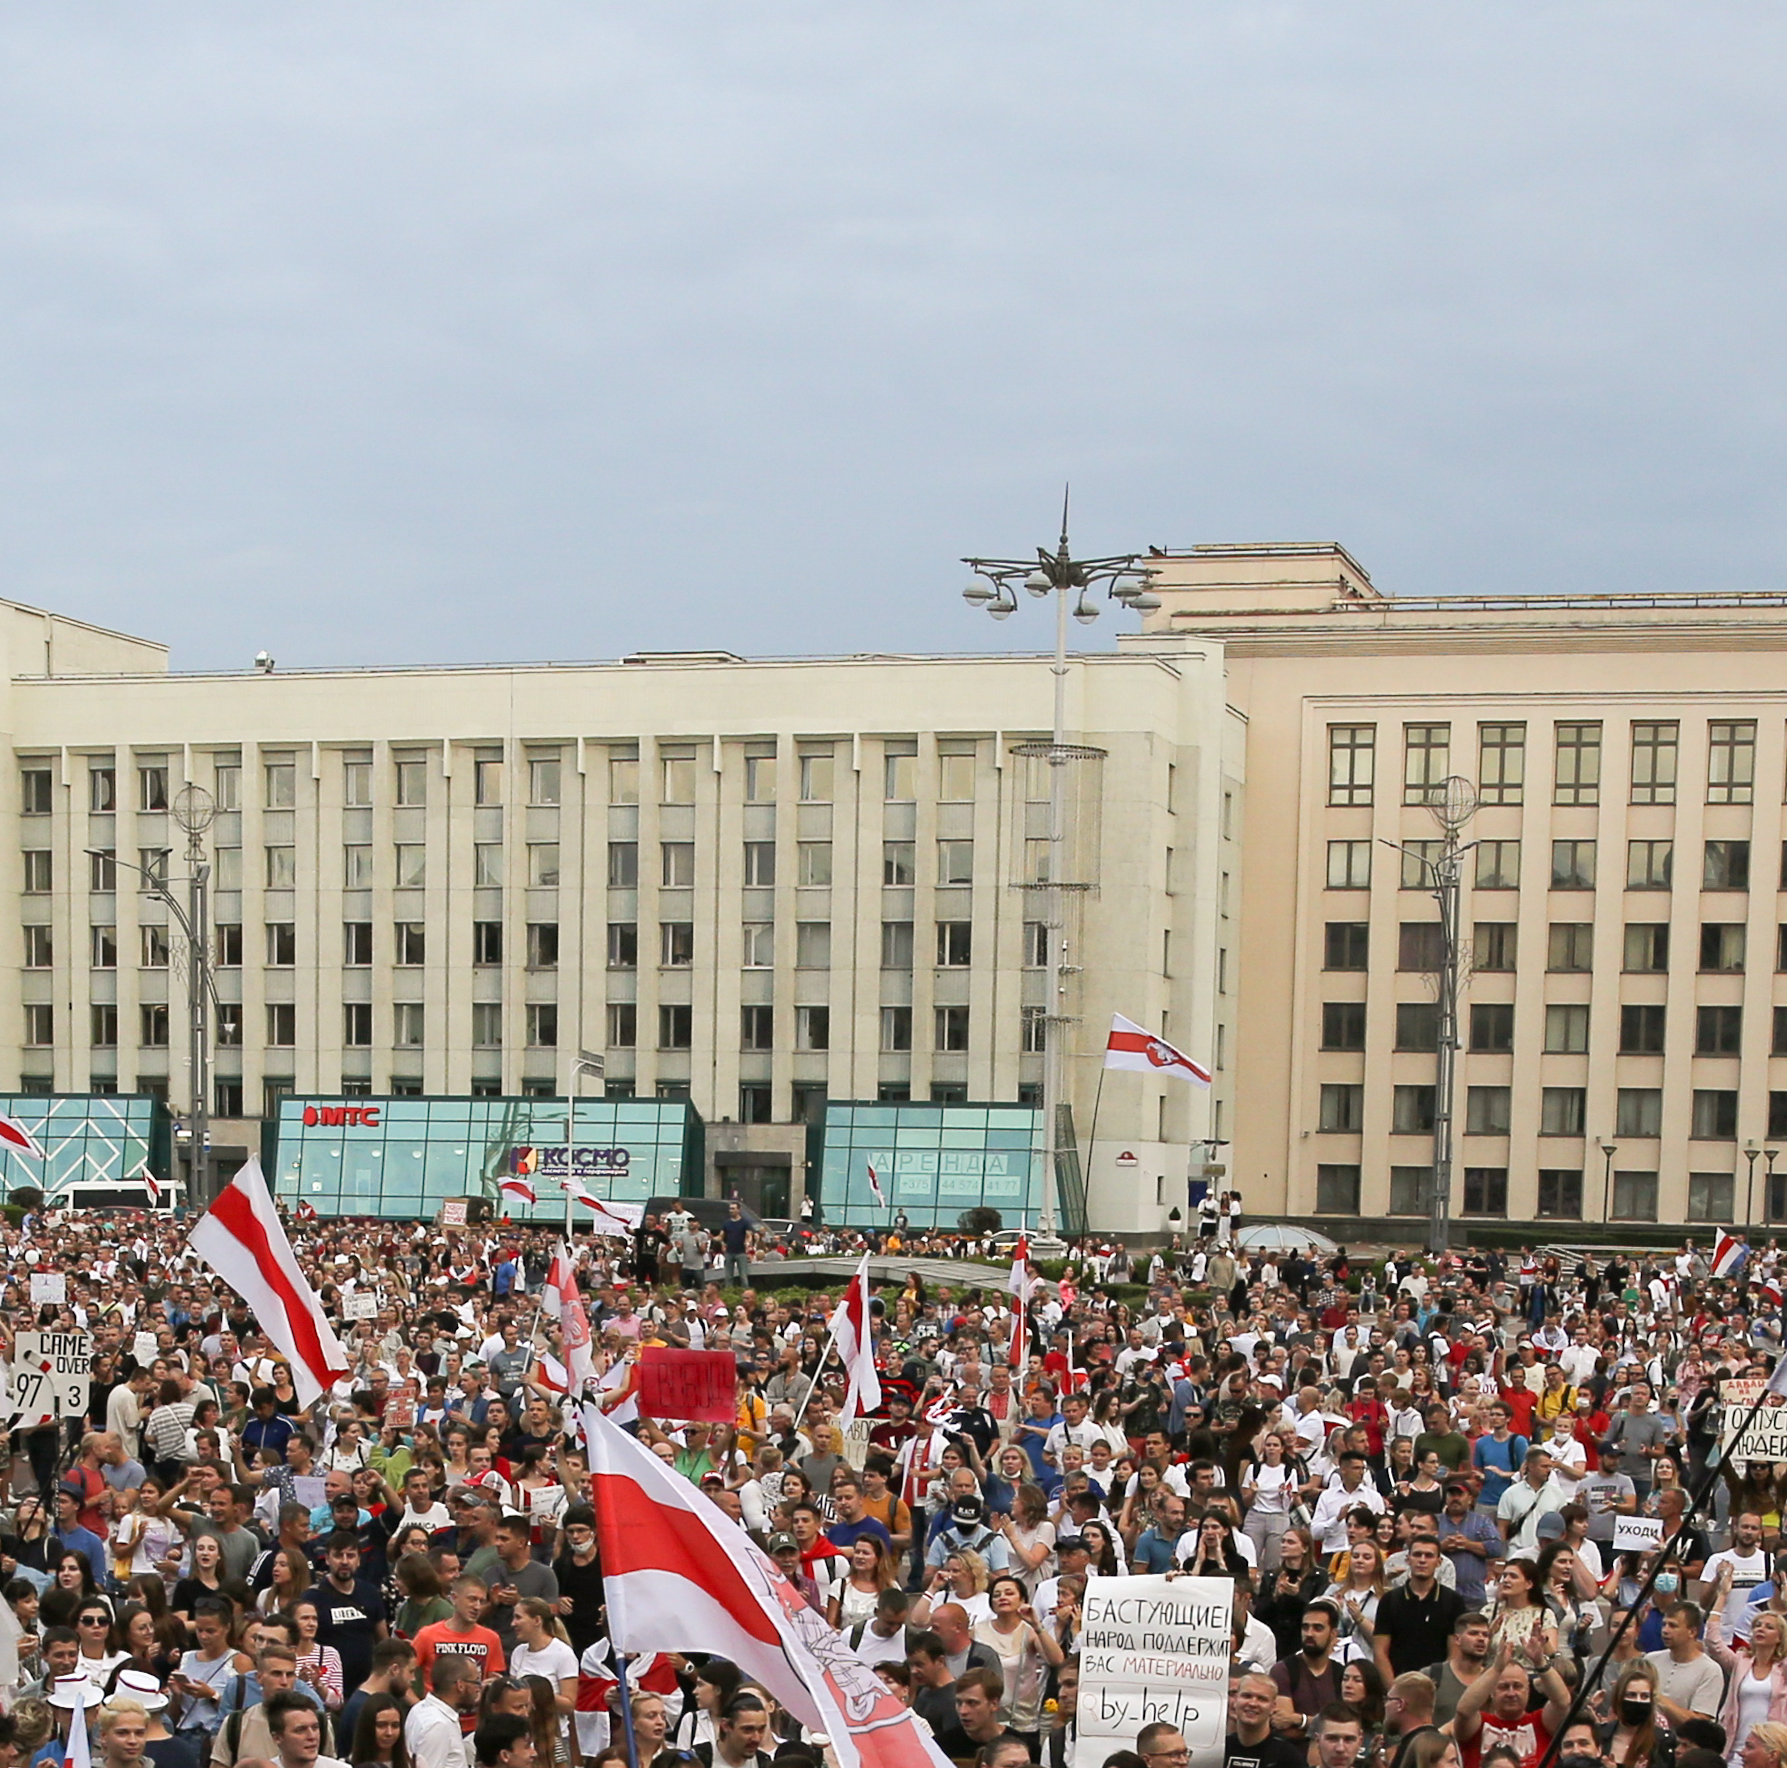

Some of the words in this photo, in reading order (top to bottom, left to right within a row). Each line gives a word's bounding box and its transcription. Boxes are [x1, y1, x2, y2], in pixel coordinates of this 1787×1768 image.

[320, 1107, 380, 1127] МТС
[542, 1147, 631, 1167] КОСМО
[875, 1153, 1004, 1173] АРЕНДА
[56, 1357, 90, 1374] OVER
[17, 1373, 43, 1408] 97
[68, 1386, 81, 1408] 3
[1618, 1524, 1659, 1539] УХОДИ
[1086, 1597, 1230, 1634] БАСТУЮЩИЕ!
[435, 1643, 459, 1655] PINK
[459, 1643, 488, 1656] FLOYD
[1085, 1629, 1136, 1651] НАРОД
[1143, 1632, 1231, 1658] ПОДДЕРЖИТ
[1085, 1655, 1116, 1673] ВАС
[1123, 1656, 1225, 1682] МАТЕРИАЛЬНО
[1101, 1686, 1200, 1737] by_help
